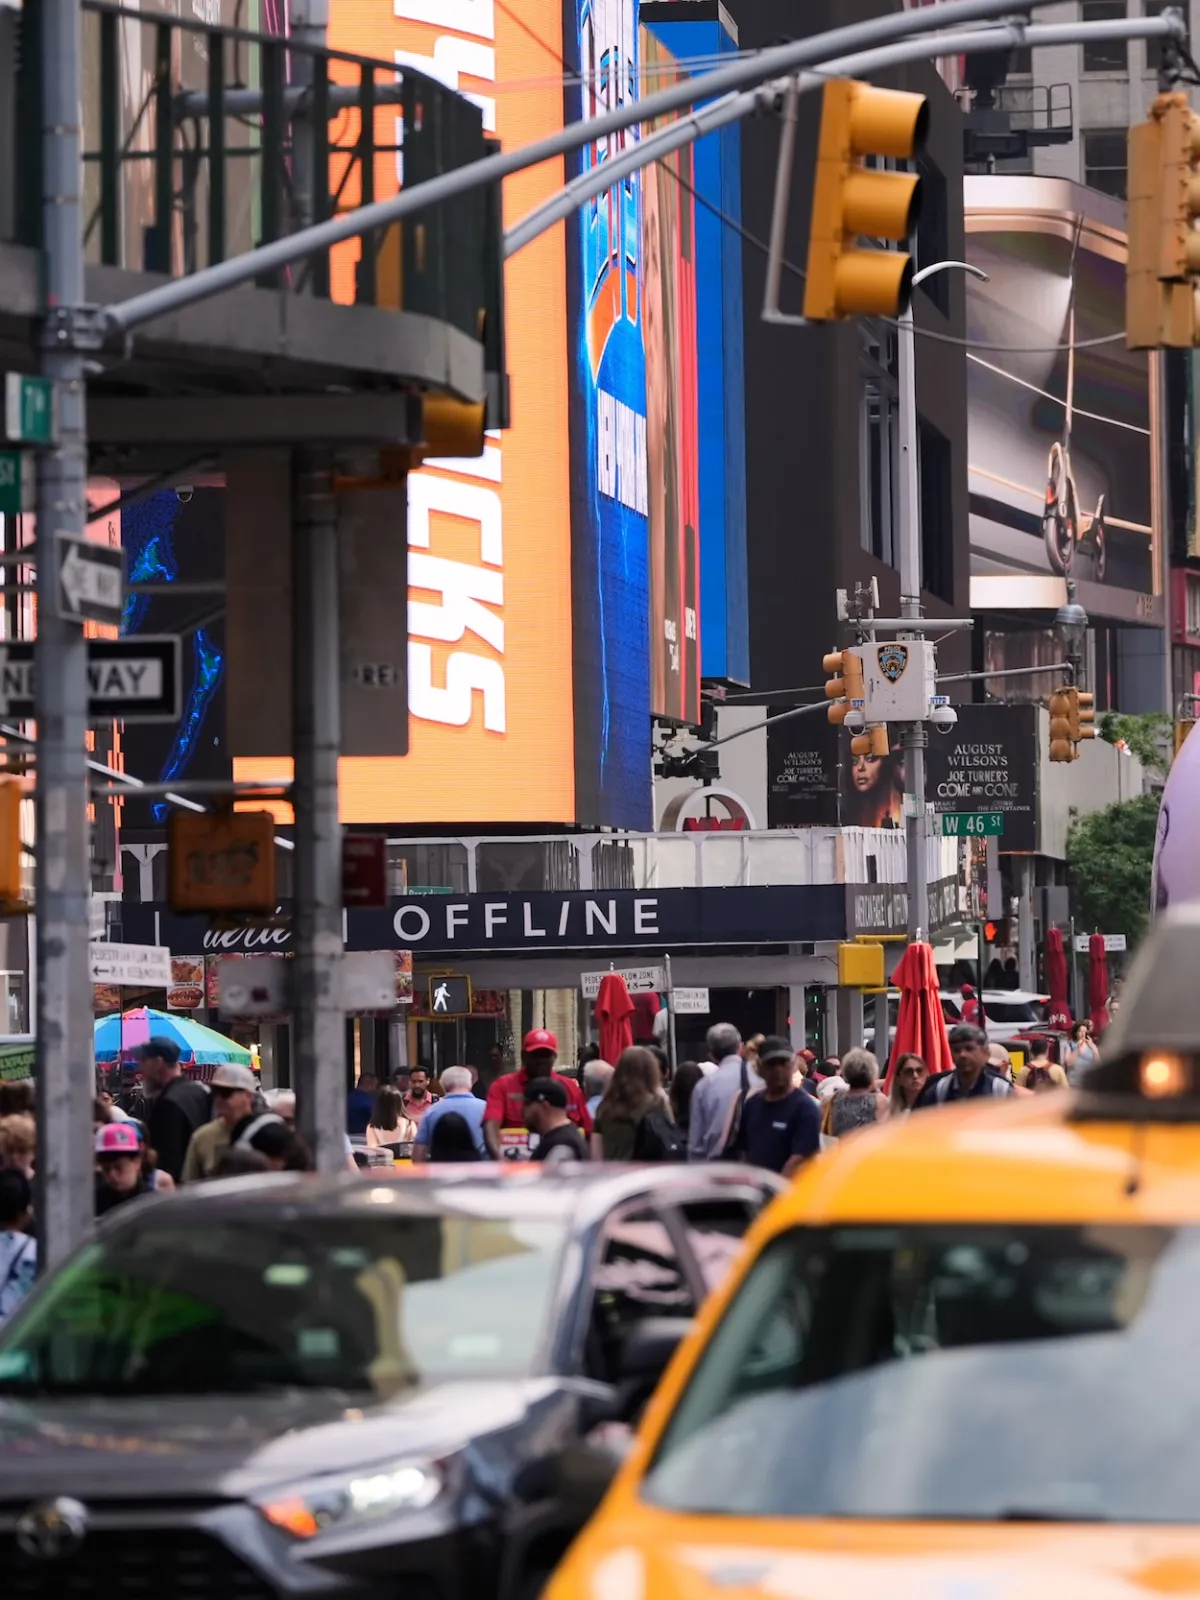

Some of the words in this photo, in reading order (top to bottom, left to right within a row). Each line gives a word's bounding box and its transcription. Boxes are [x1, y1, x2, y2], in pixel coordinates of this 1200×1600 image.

[787, 751, 820, 759] AUGUST
[954, 744, 1003, 755] AUGUST
[947, 756, 1008, 766] WILSON'S
[783, 767, 795, 775] JOE
[946, 770, 965, 782] JOE
[968, 770, 1008, 782] TURNER'S
[776, 774, 798, 783] COME
[937, 783, 971, 797] COME
[984, 783, 1019, 797] GONE
[945, 816, 959, 834] W
[966, 815, 985, 833] 46
[991, 815, 1001, 827] St
[393, 898, 660, 942] OFFLINE
[584, 975, 603, 985] PEDES
[621, 972, 637, 981] FLOW
[638, 970, 655, 980] ZONE
